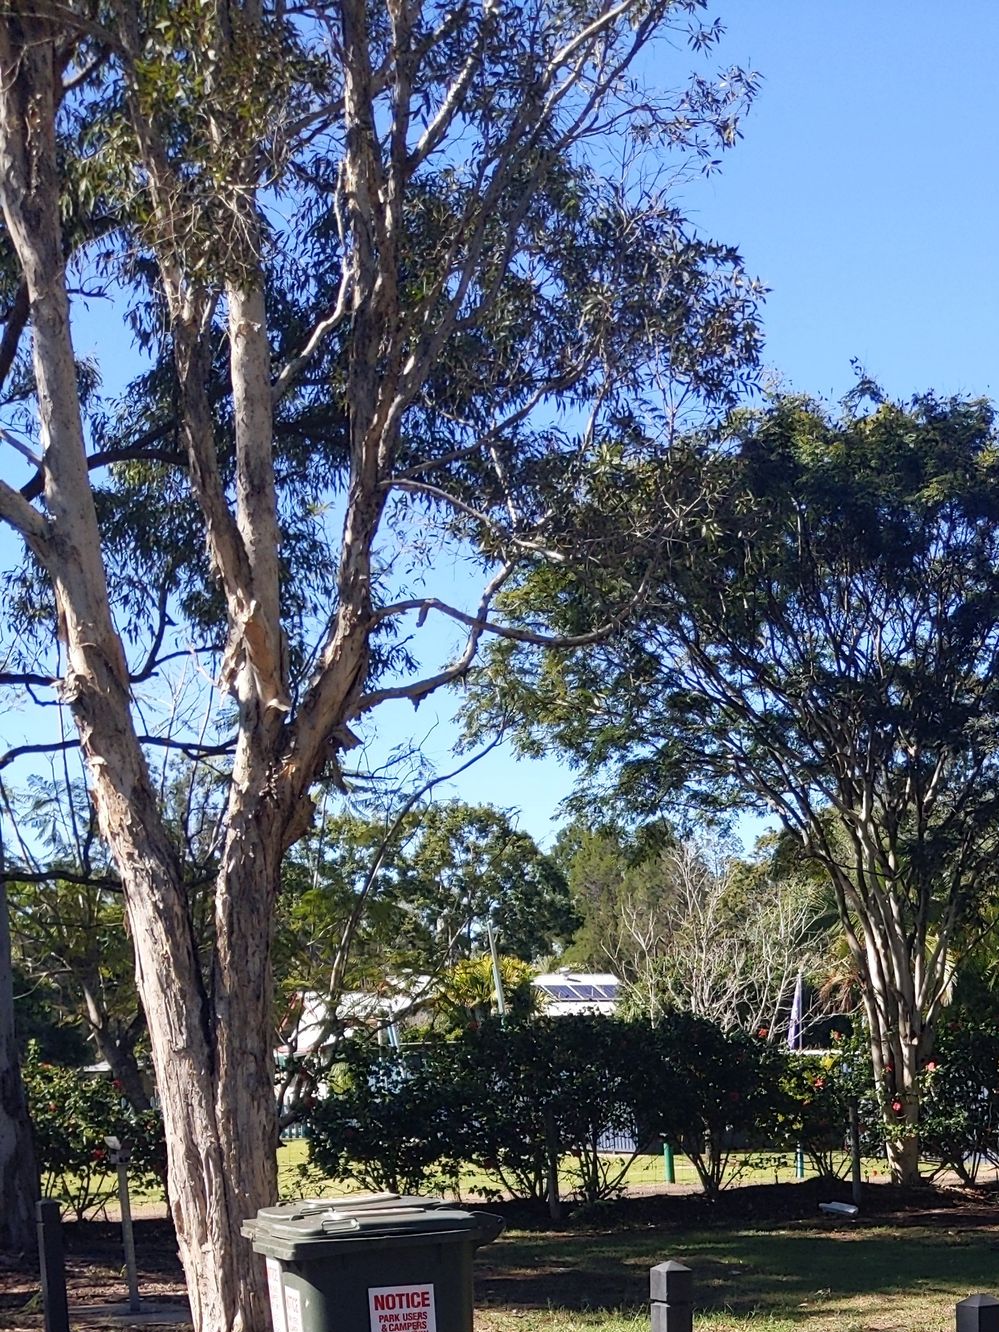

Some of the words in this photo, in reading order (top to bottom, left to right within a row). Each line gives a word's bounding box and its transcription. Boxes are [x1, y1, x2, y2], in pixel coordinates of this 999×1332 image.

[374, 1292, 430, 1310] NOTICE
[379, 1314, 400, 1323] PARK
[403, 1312, 427, 1321] USERS
[381, 1324, 387, 1332] &
[388, 1321, 427, 1331] CAMPERS
